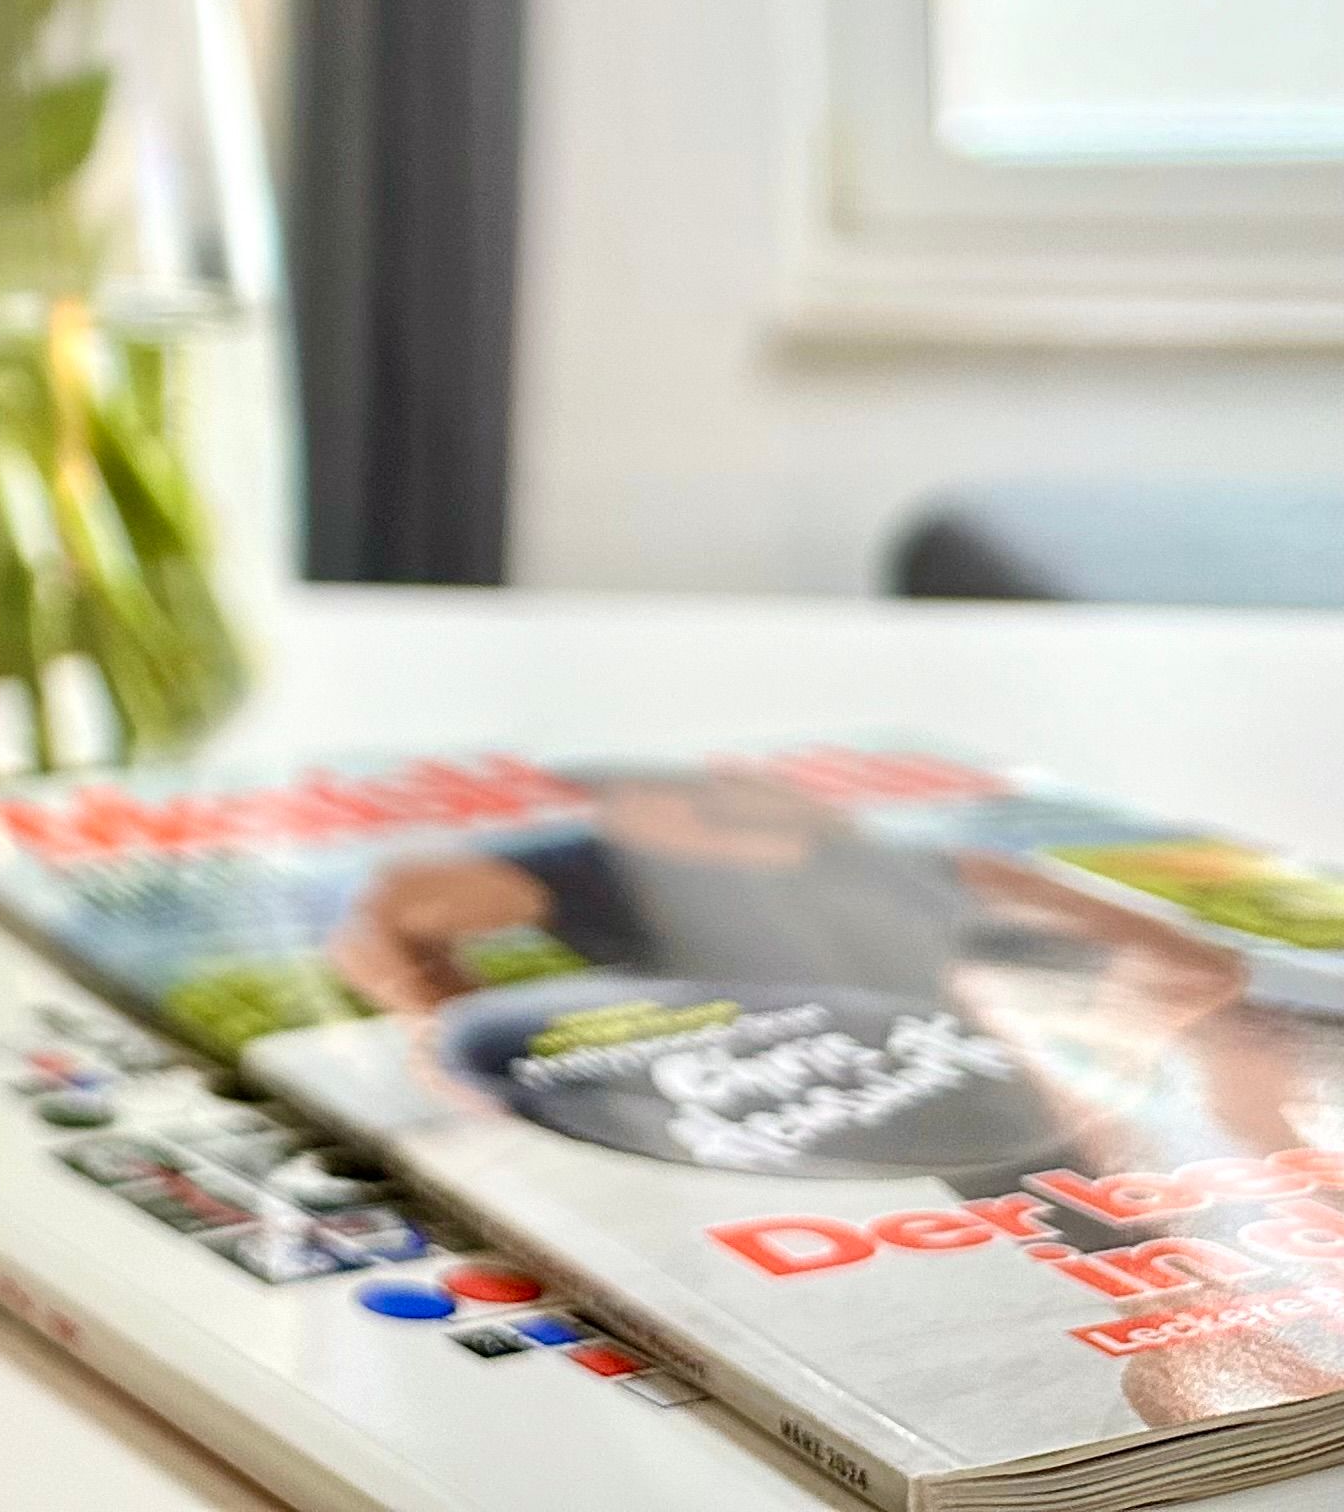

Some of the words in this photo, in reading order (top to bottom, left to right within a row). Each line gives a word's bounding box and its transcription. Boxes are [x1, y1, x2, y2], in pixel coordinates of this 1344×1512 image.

[705, 1191, 1054, 1279] Der
[1023, 1236, 1262, 1300] in
[1086, 1298, 1314, 1354] Leckere
